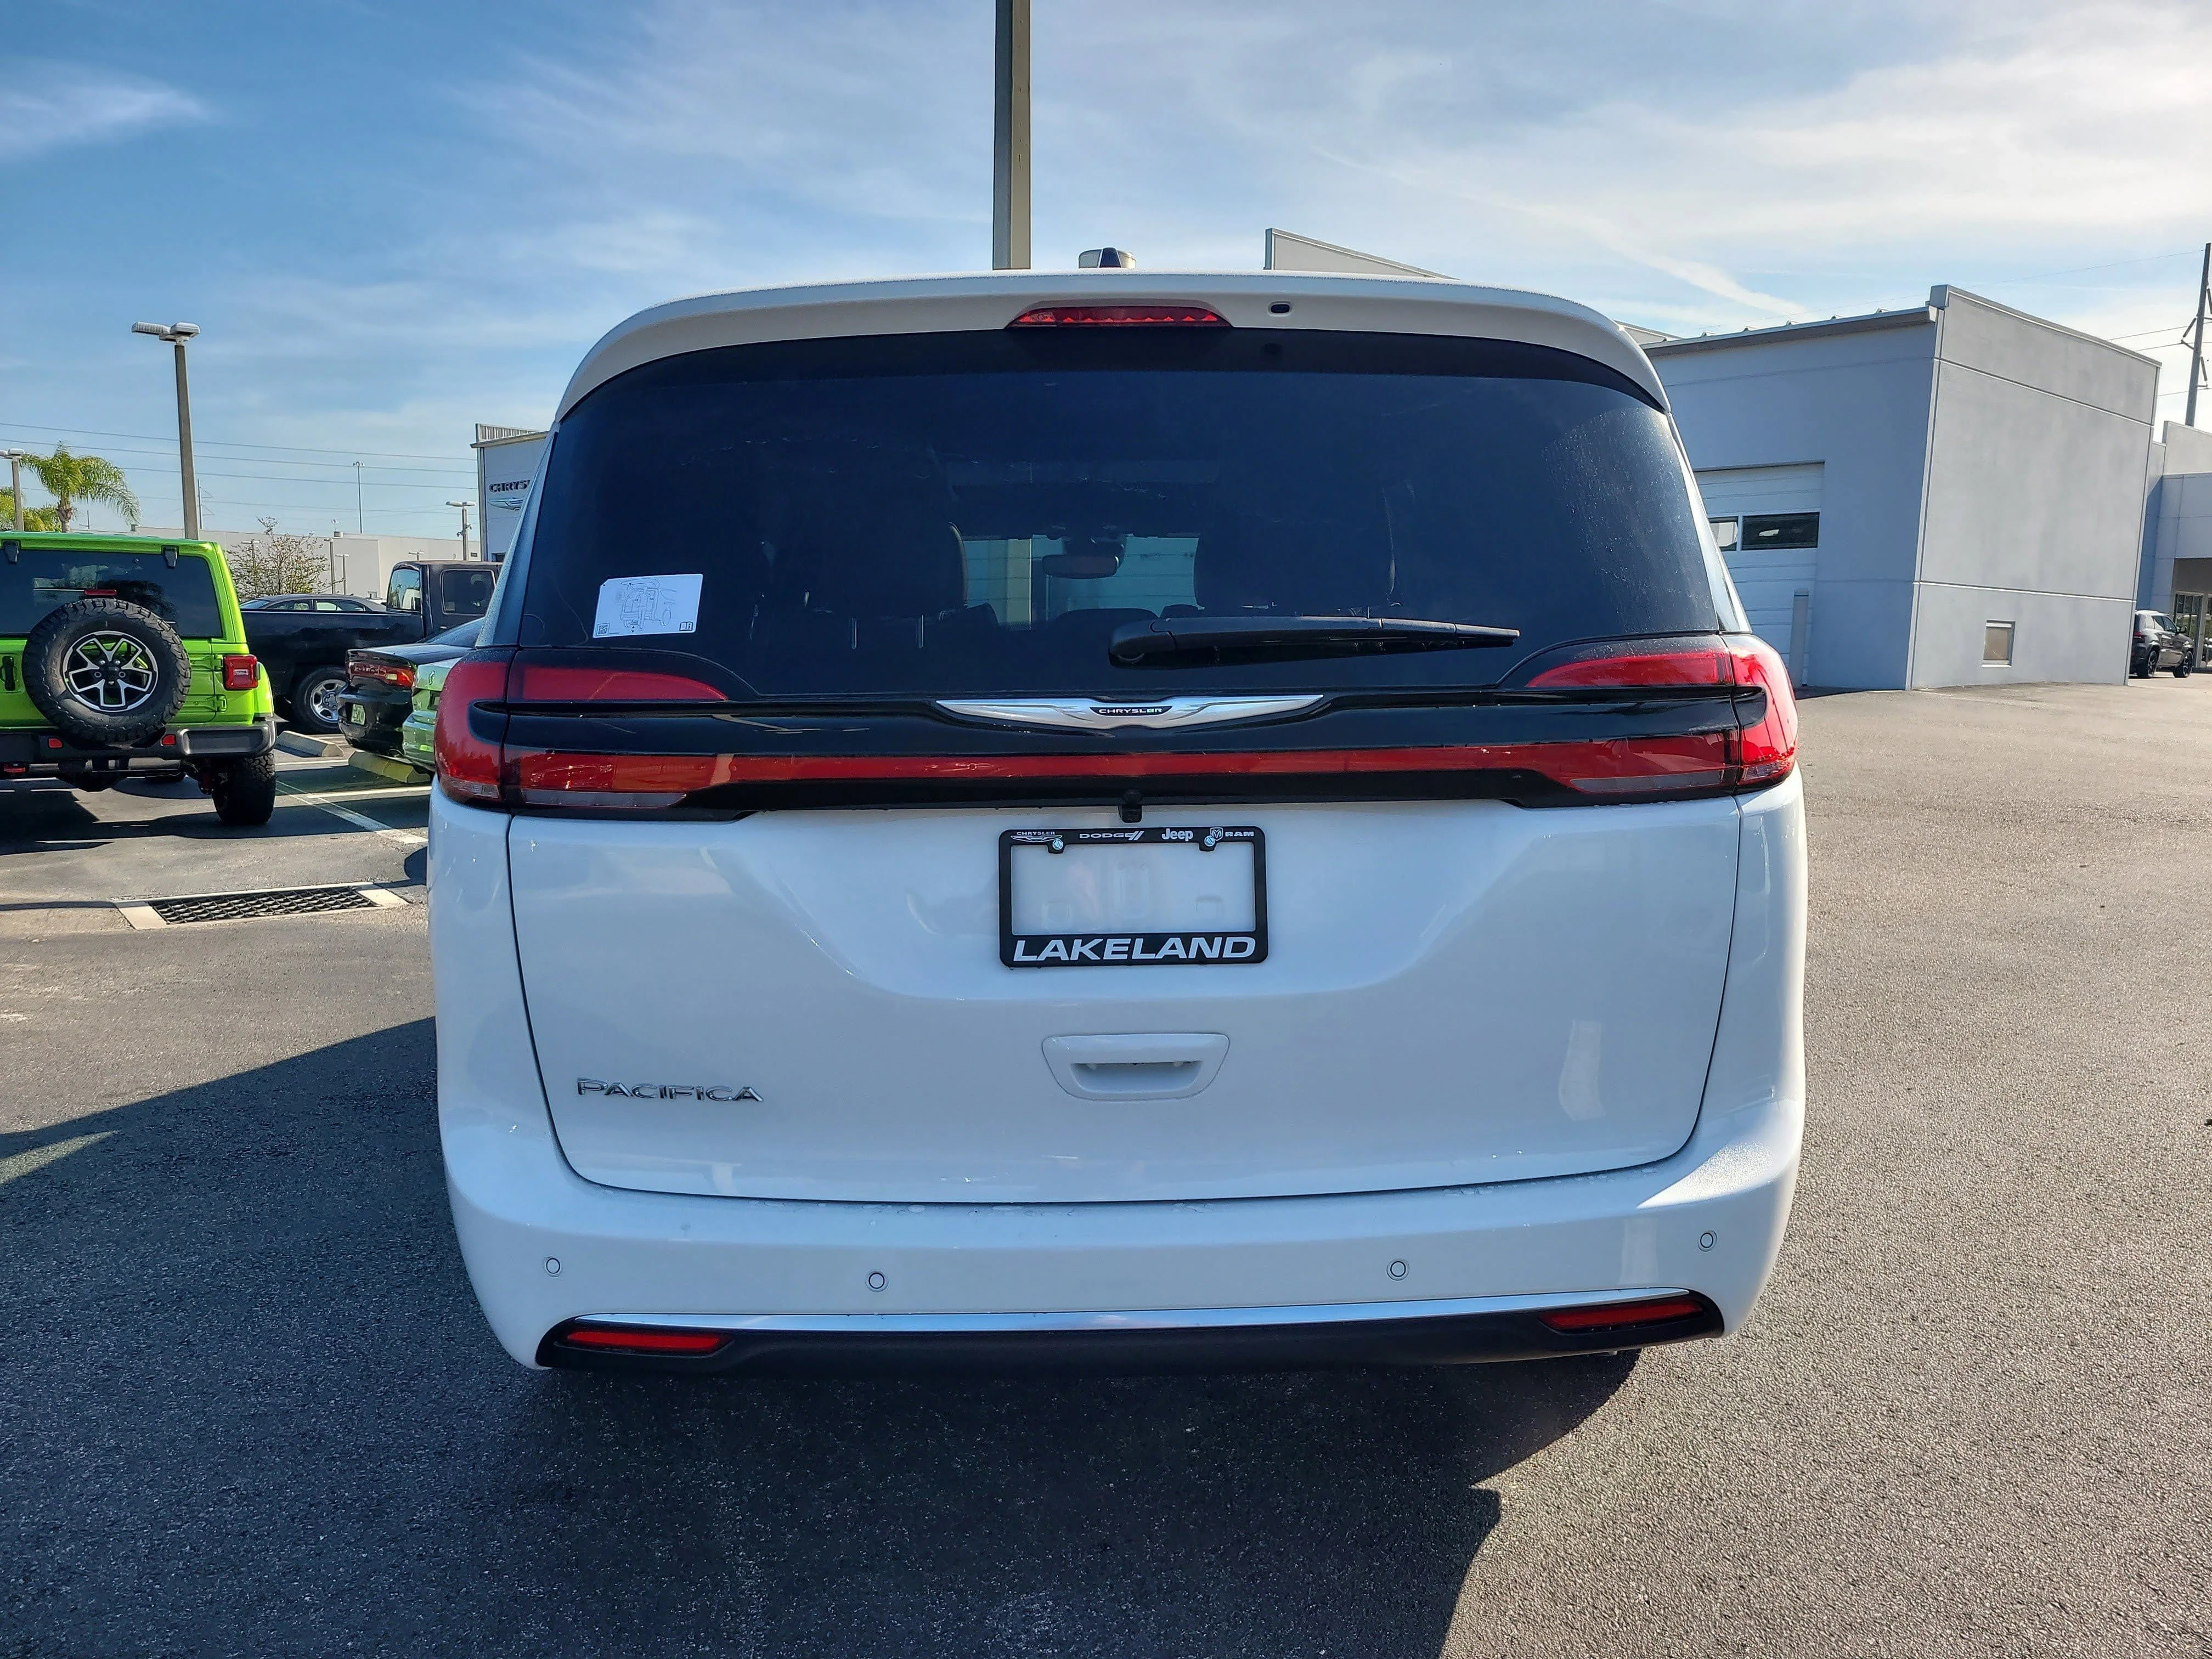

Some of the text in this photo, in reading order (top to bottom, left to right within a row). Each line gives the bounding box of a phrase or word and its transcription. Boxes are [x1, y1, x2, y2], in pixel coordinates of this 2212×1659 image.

[1161, 828, 1193, 841] Jeep
[1013, 937, 1256, 961] LAKELAND
[577, 1077, 764, 1102] PACIFICA
